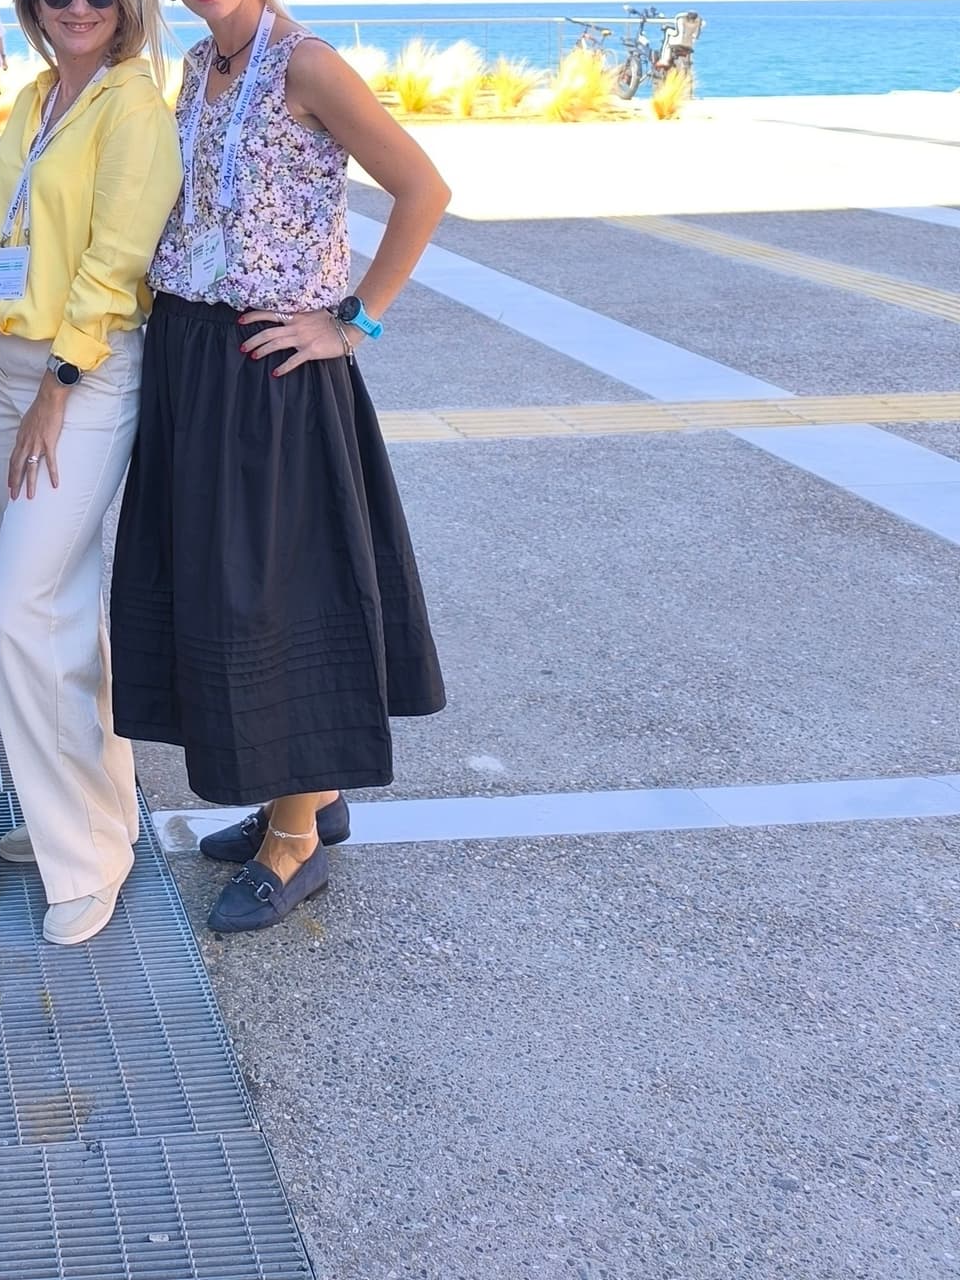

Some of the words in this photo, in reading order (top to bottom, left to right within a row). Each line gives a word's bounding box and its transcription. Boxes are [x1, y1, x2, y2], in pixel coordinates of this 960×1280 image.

[252, 27, 271, 65] ANTISEL
[234, 83, 254, 120] ANTISEL
[223, 143, 237, 185] ANTISEL
